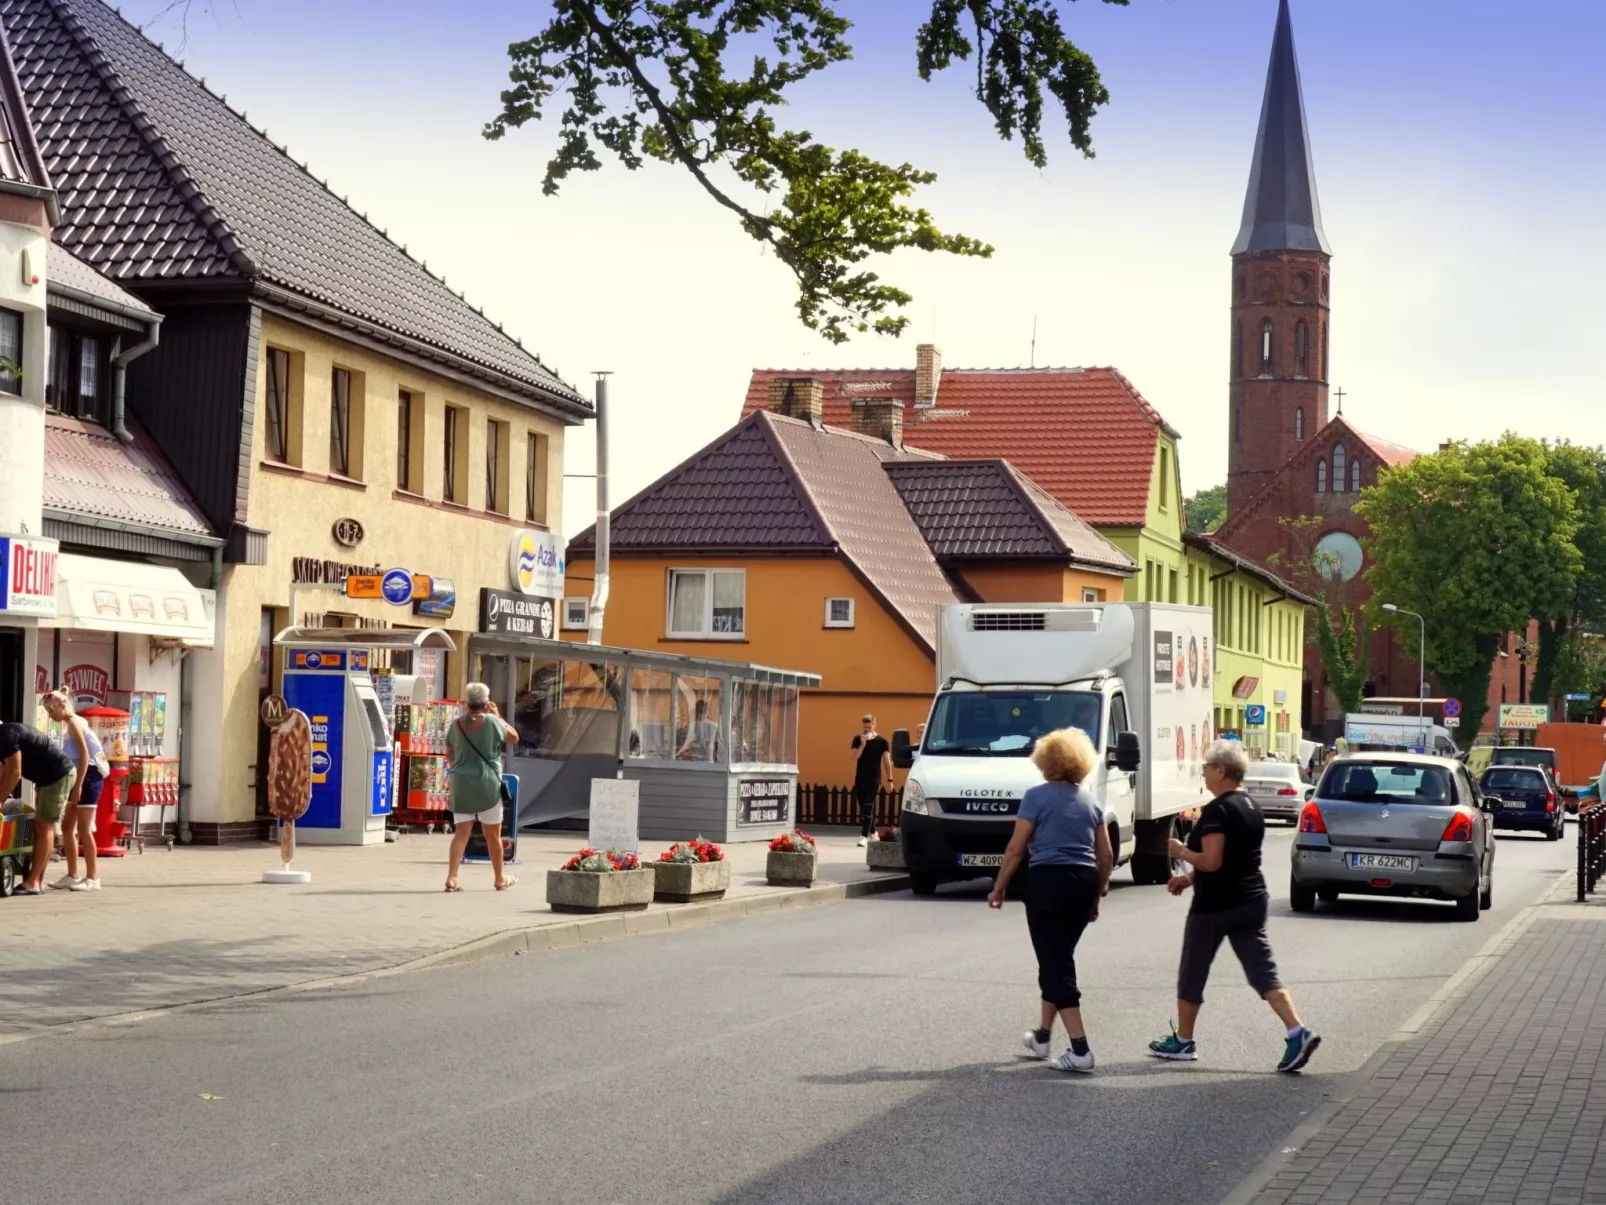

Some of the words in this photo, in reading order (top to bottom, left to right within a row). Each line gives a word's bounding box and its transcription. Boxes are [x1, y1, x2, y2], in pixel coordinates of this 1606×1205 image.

[537, 544, 557, 568] Azak
[293, 557, 322, 584] SKLEP
[500, 598, 515, 614] PIZZA
[515, 601, 541, 618] GRANDE
[507, 616, 512, 631] &
[512, 617, 534, 633] KEBAB
[67, 667, 106, 695] ŻYWIEC
[268, 702, 282, 717] M
[311, 724, 328, 733] nko
[959, 789, 1014, 797] IGLOTEX
[966, 802, 1009, 812] IVECO
[963, 856, 977, 865] WZ
[980, 856, 1004, 866] 4090
[1359, 856, 1375, 867] KR
[1378, 857, 1410, 869] 622MC
